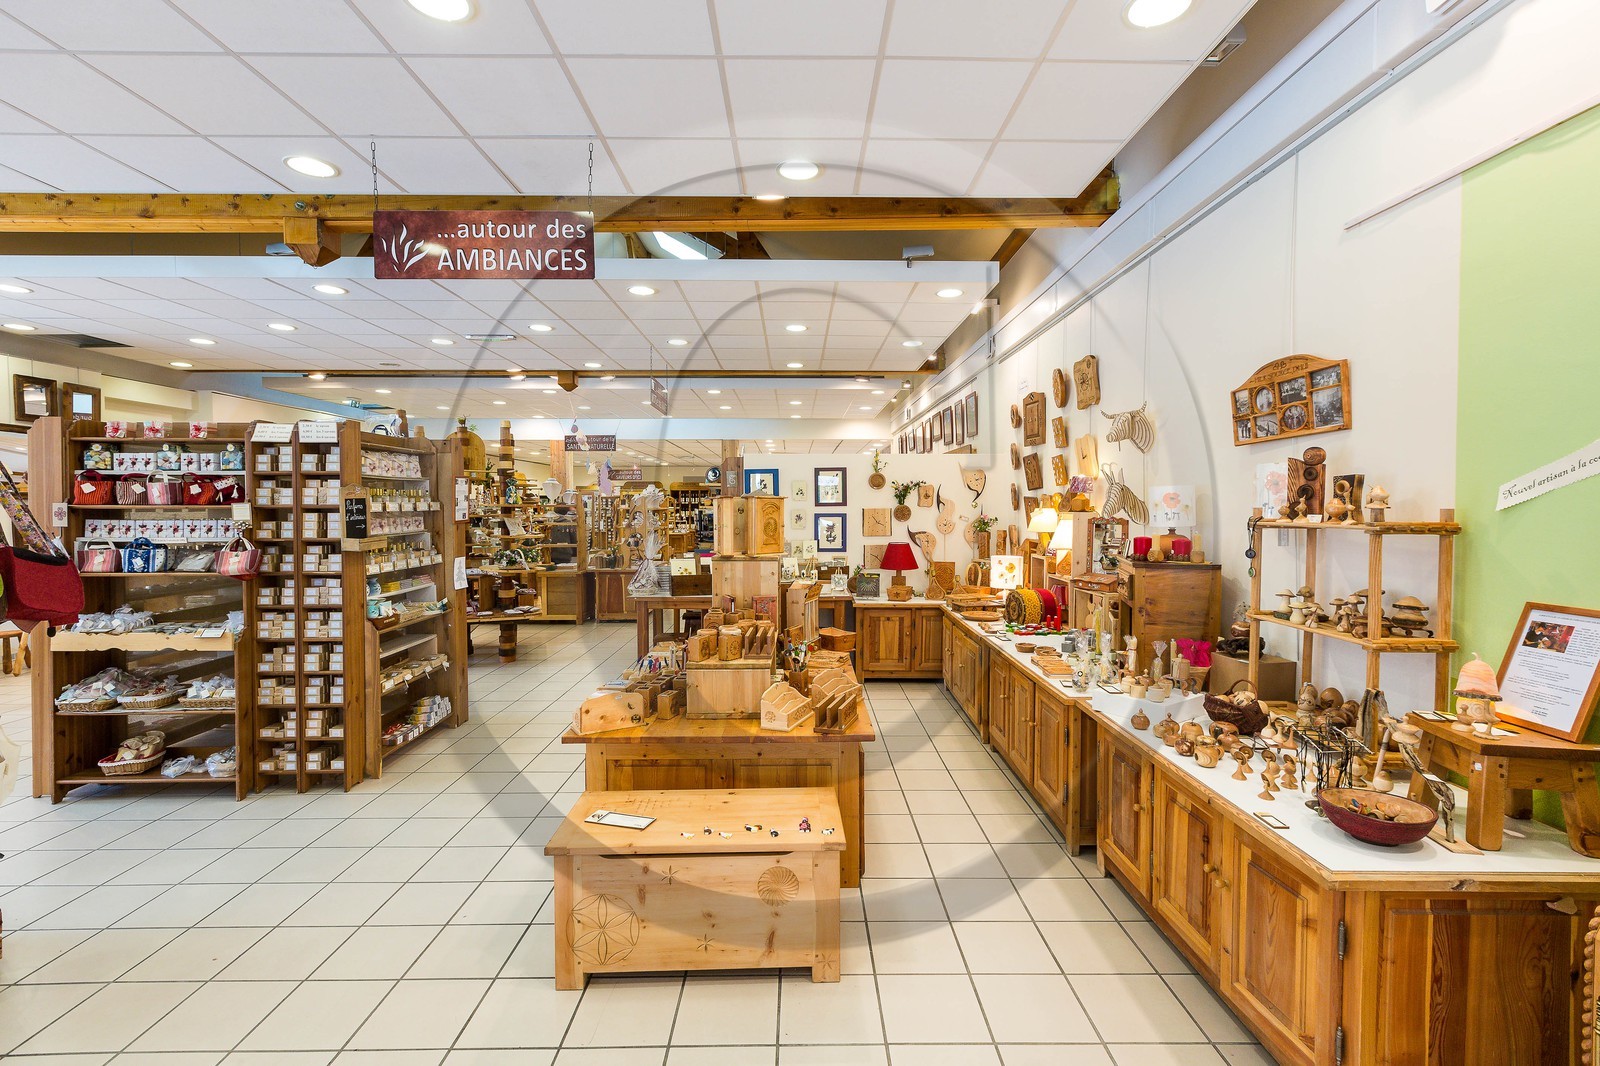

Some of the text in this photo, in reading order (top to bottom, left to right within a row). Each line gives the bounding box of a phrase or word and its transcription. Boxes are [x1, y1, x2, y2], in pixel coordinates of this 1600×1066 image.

[437, 218, 586, 239] ...autour des
[437, 248, 587, 272] AMBIANCES
[1502, 479, 1537, 501] Nouvel
[1537, 469, 1569, 486] artisan
[1570, 464, 1576, 473] à
[1577, 459, 1587, 470] la
